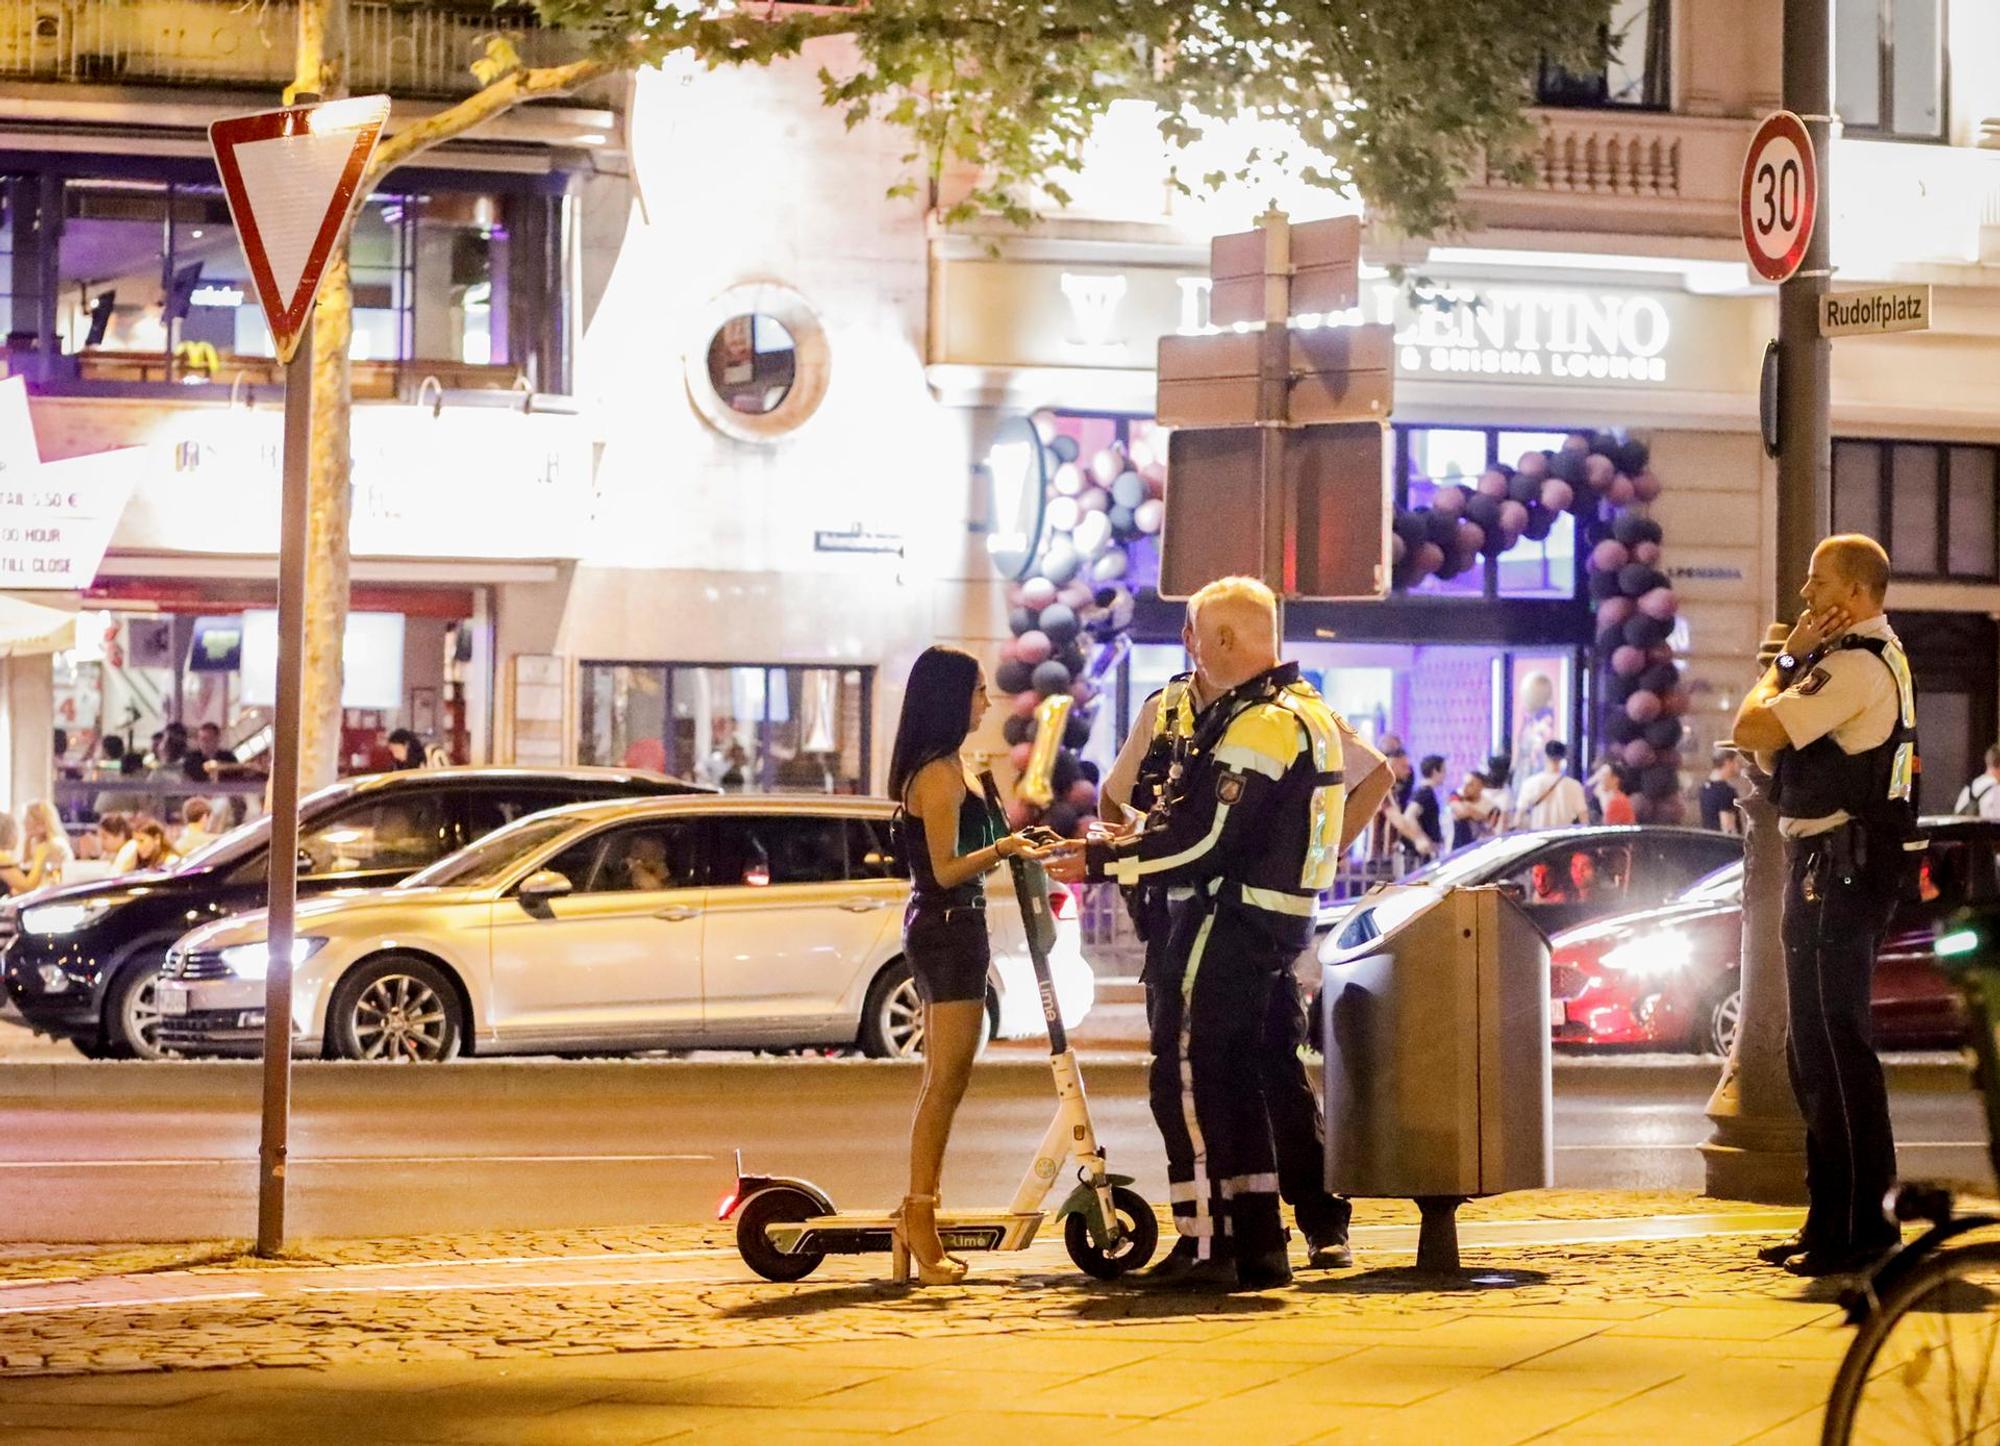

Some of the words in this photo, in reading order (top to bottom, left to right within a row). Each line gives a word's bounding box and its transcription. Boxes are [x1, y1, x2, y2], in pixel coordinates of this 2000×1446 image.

[1757, 159, 1799, 235] 30
[1827, 295, 1922, 328] Rudolfplatz
[1552, 354, 1667, 381] LOUNGE
[25, 529, 61, 542] HOUR
[32, 558, 71, 573] CLOSE
